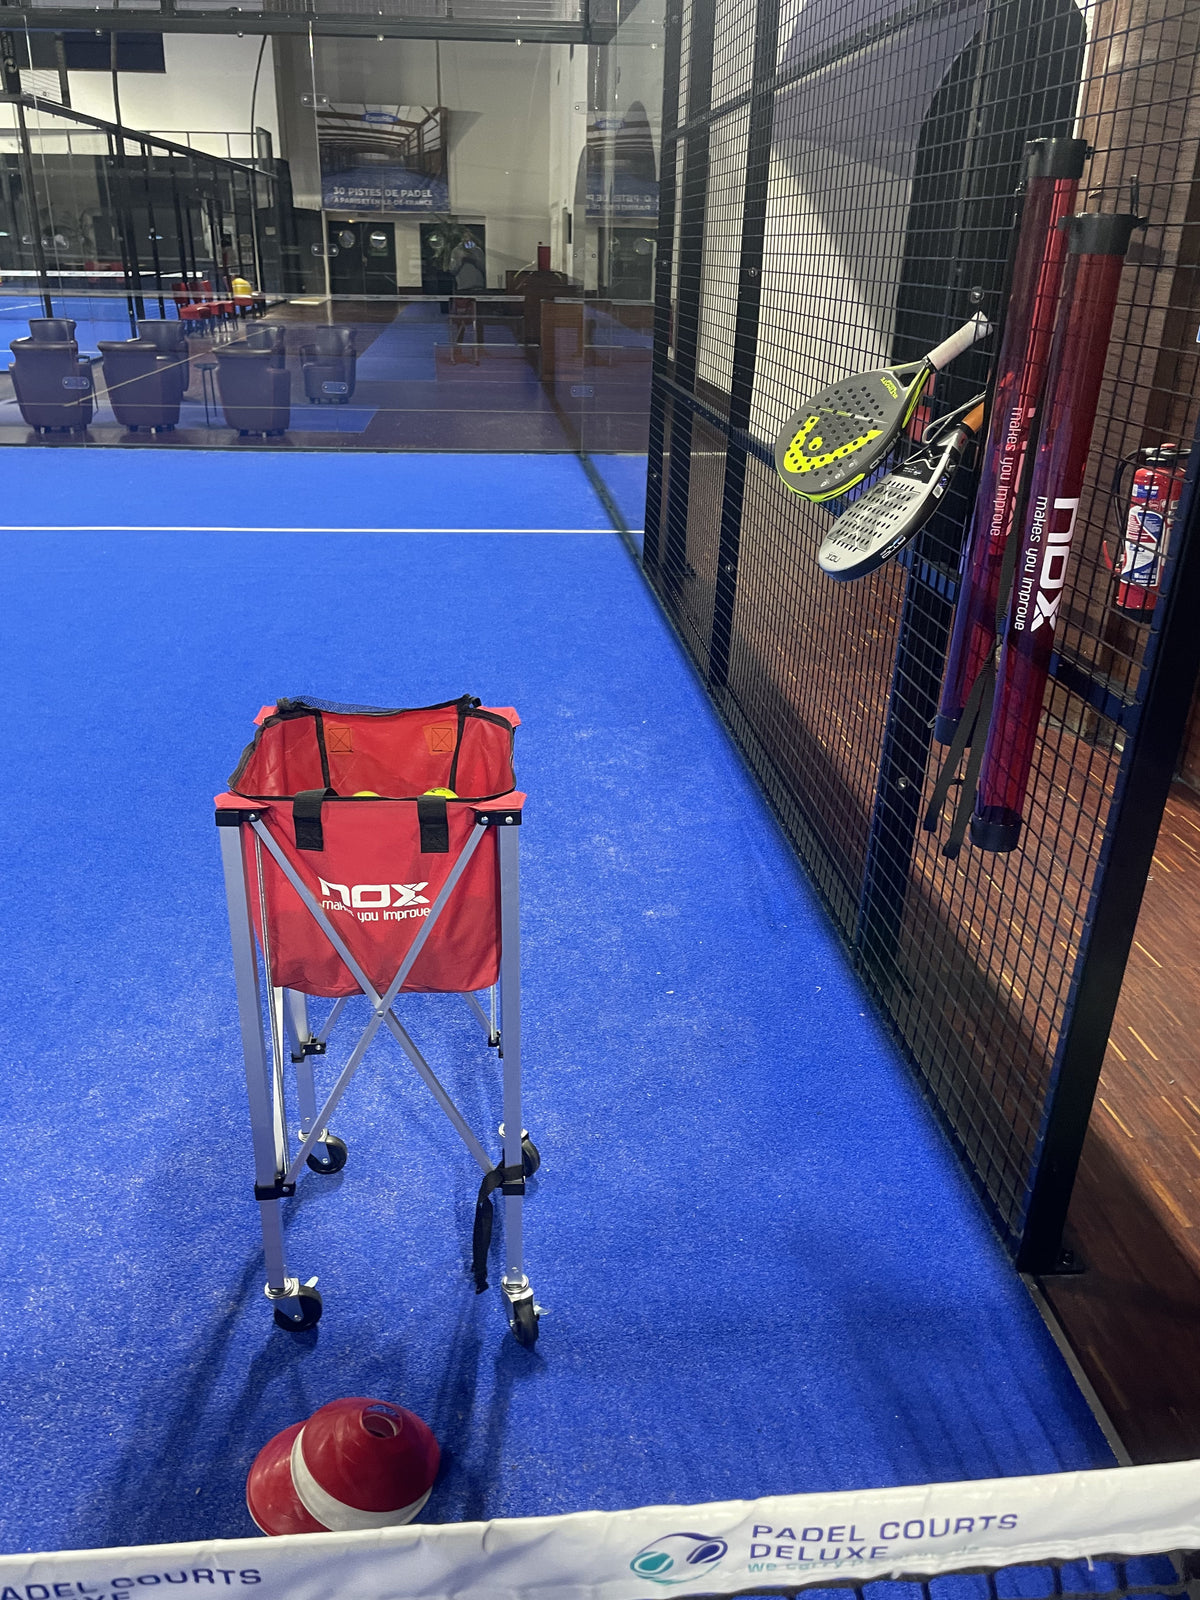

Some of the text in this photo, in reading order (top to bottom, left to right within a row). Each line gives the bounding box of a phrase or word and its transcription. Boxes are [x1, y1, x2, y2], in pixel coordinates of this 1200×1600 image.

[333, 187, 433, 198] 30 PISTES DE PADEL
[1006, 407, 1023, 452] makes
[999, 457, 1014, 485] you
[1030, 496, 1048, 543] makes
[1024, 548, 1040, 573] you
[357, 911, 379, 923] you
[751, 1513, 1019, 1543] PADEL COURTS
[749, 1543, 889, 1561] DELUXE
[0, 1568, 262, 1600] ADEL COURTS
